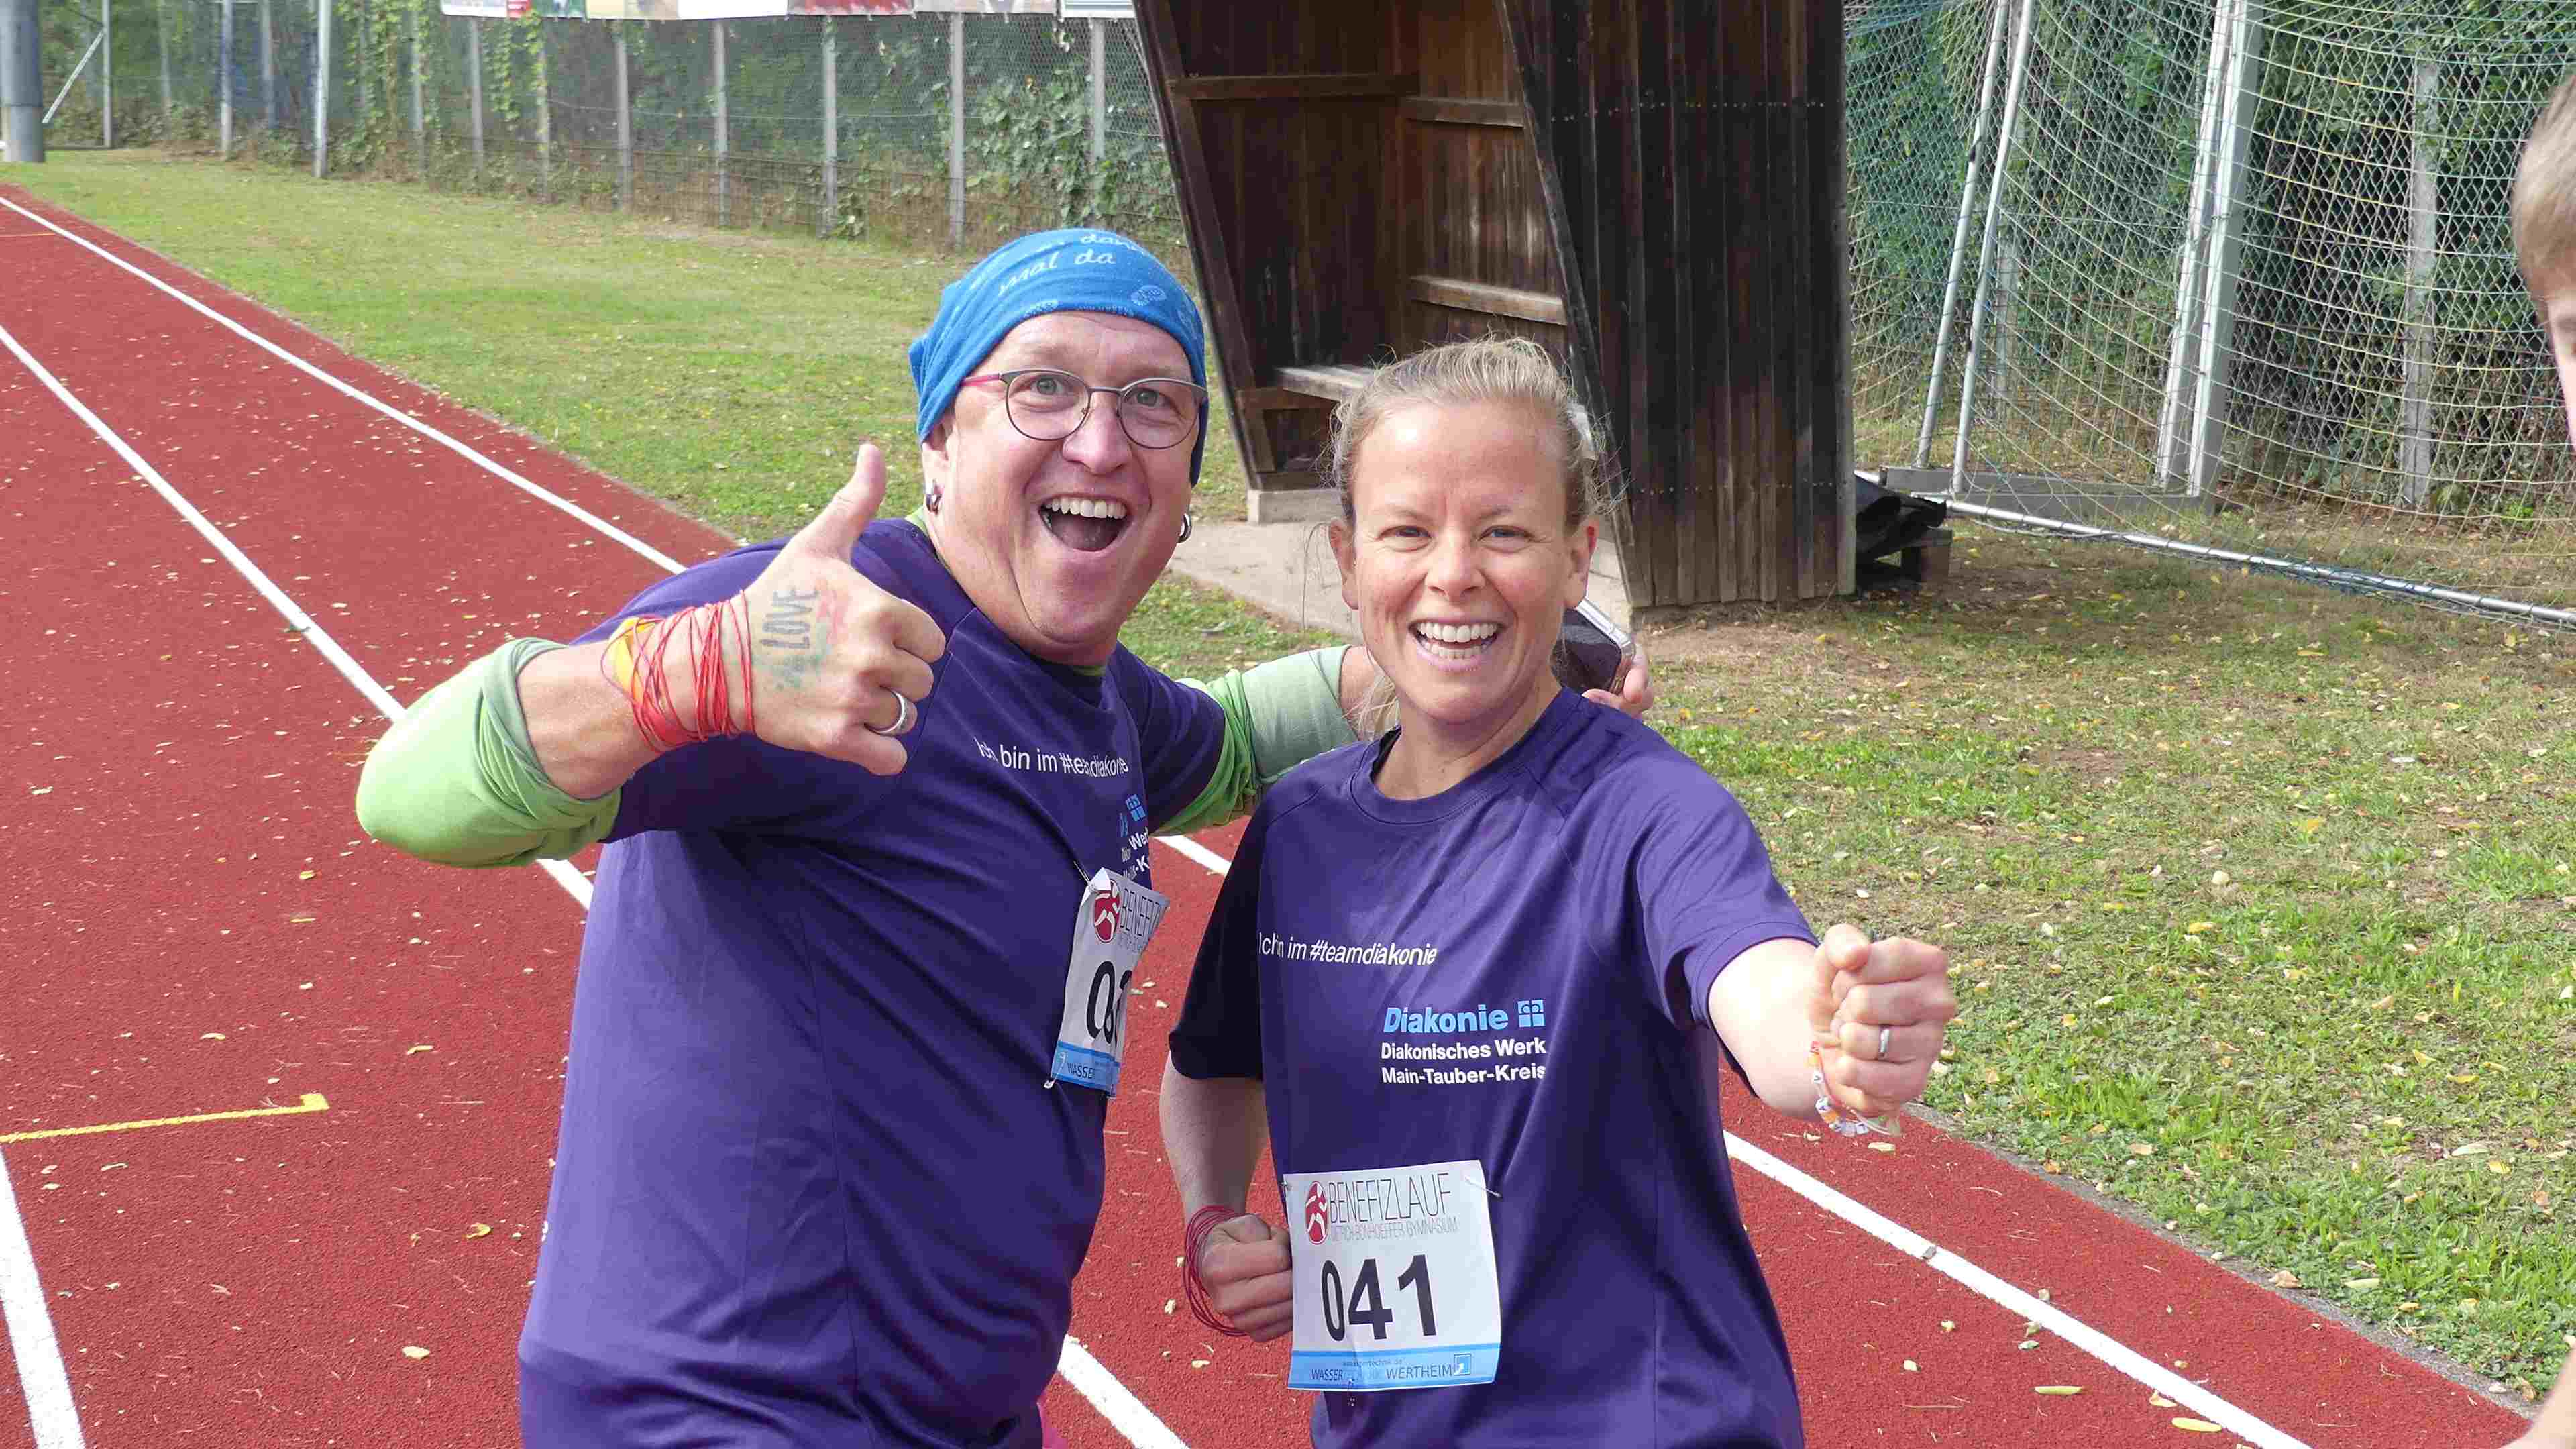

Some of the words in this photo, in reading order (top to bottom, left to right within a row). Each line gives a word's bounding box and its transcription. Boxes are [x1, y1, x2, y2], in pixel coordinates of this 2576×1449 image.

[1074, 248, 1116, 265] da
[1000, 744, 1030, 770] bin
[1037, 748, 1058, 772] im
[1287, 936, 1307, 960] im
[1309, 939, 1438, 966] #teamdiakonie
[1383, 1004, 1509, 1033] Diakonie
[1381, 1042, 1491, 1060] Diakonisches
[1494, 1037, 1546, 1057] Werk
[1381, 1063, 1546, 1085] Main-Tauber-Kreis
[1328, 1172, 1450, 1224] BENEFIZLAUF
[1321, 1254, 1437, 1342] 041
[1385, 1364, 1452, 1381] WERTHEIM
